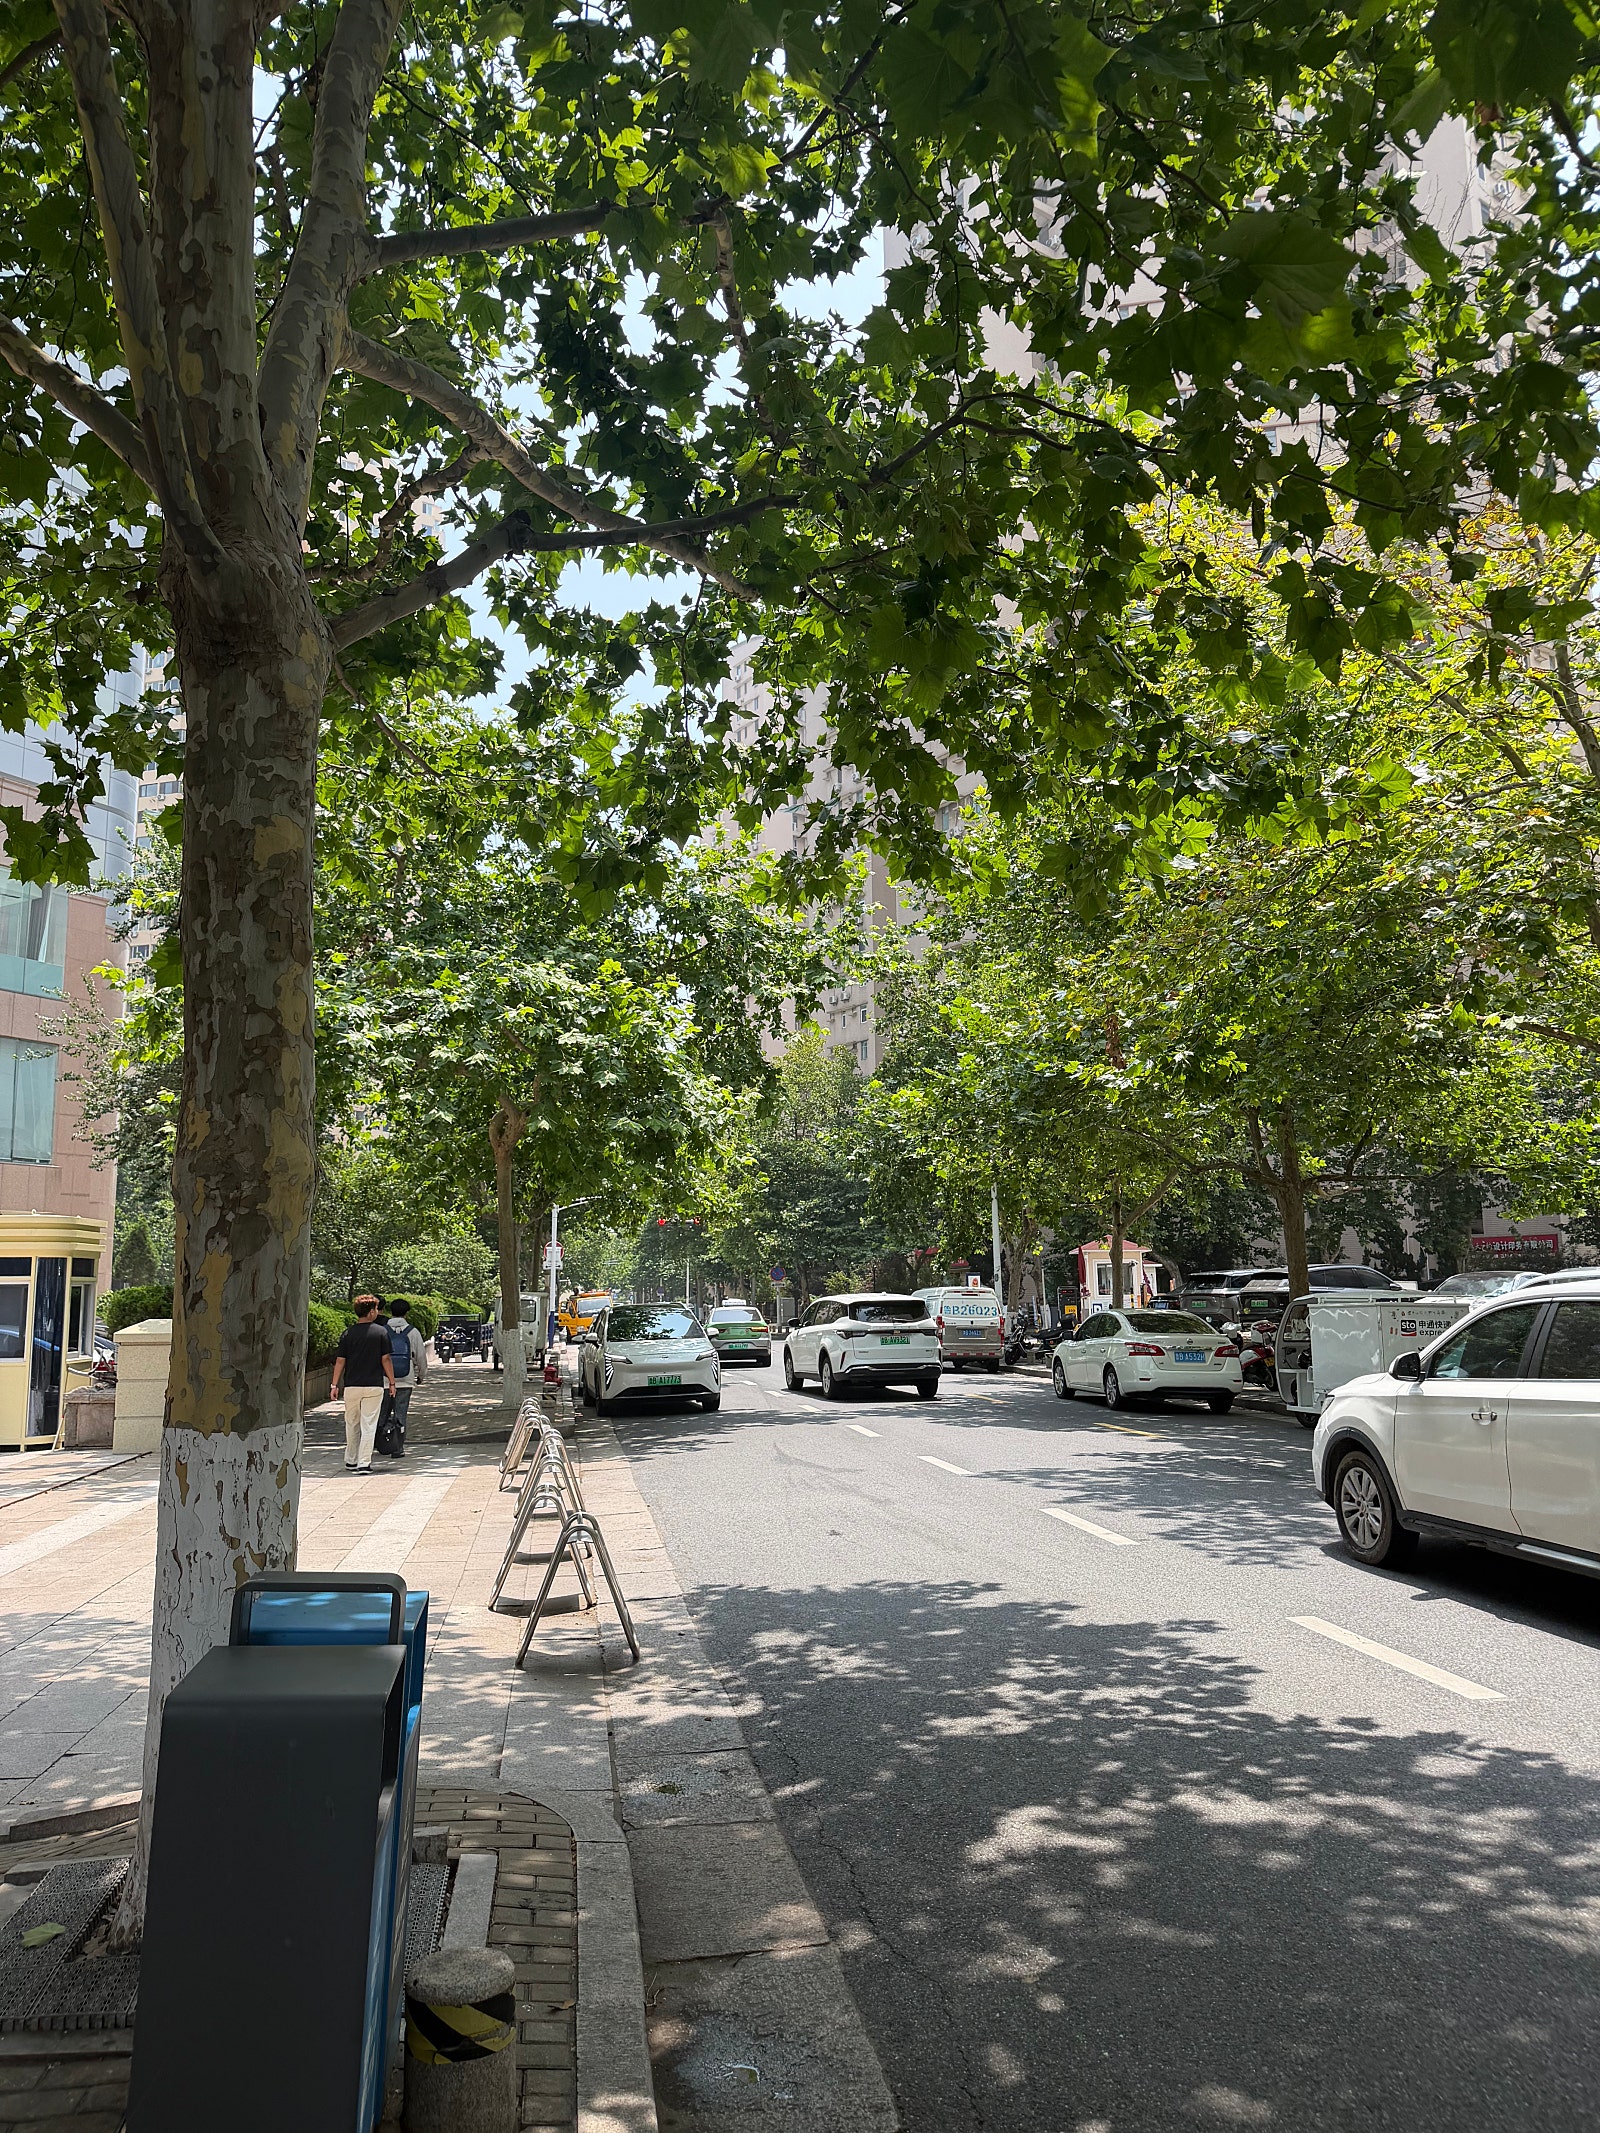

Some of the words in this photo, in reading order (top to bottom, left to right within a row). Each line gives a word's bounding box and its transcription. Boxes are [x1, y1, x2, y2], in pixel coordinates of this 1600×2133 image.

[1401, 1321, 1416, 1329] sto
[1418, 1320, 1452, 1329] 申通快递
